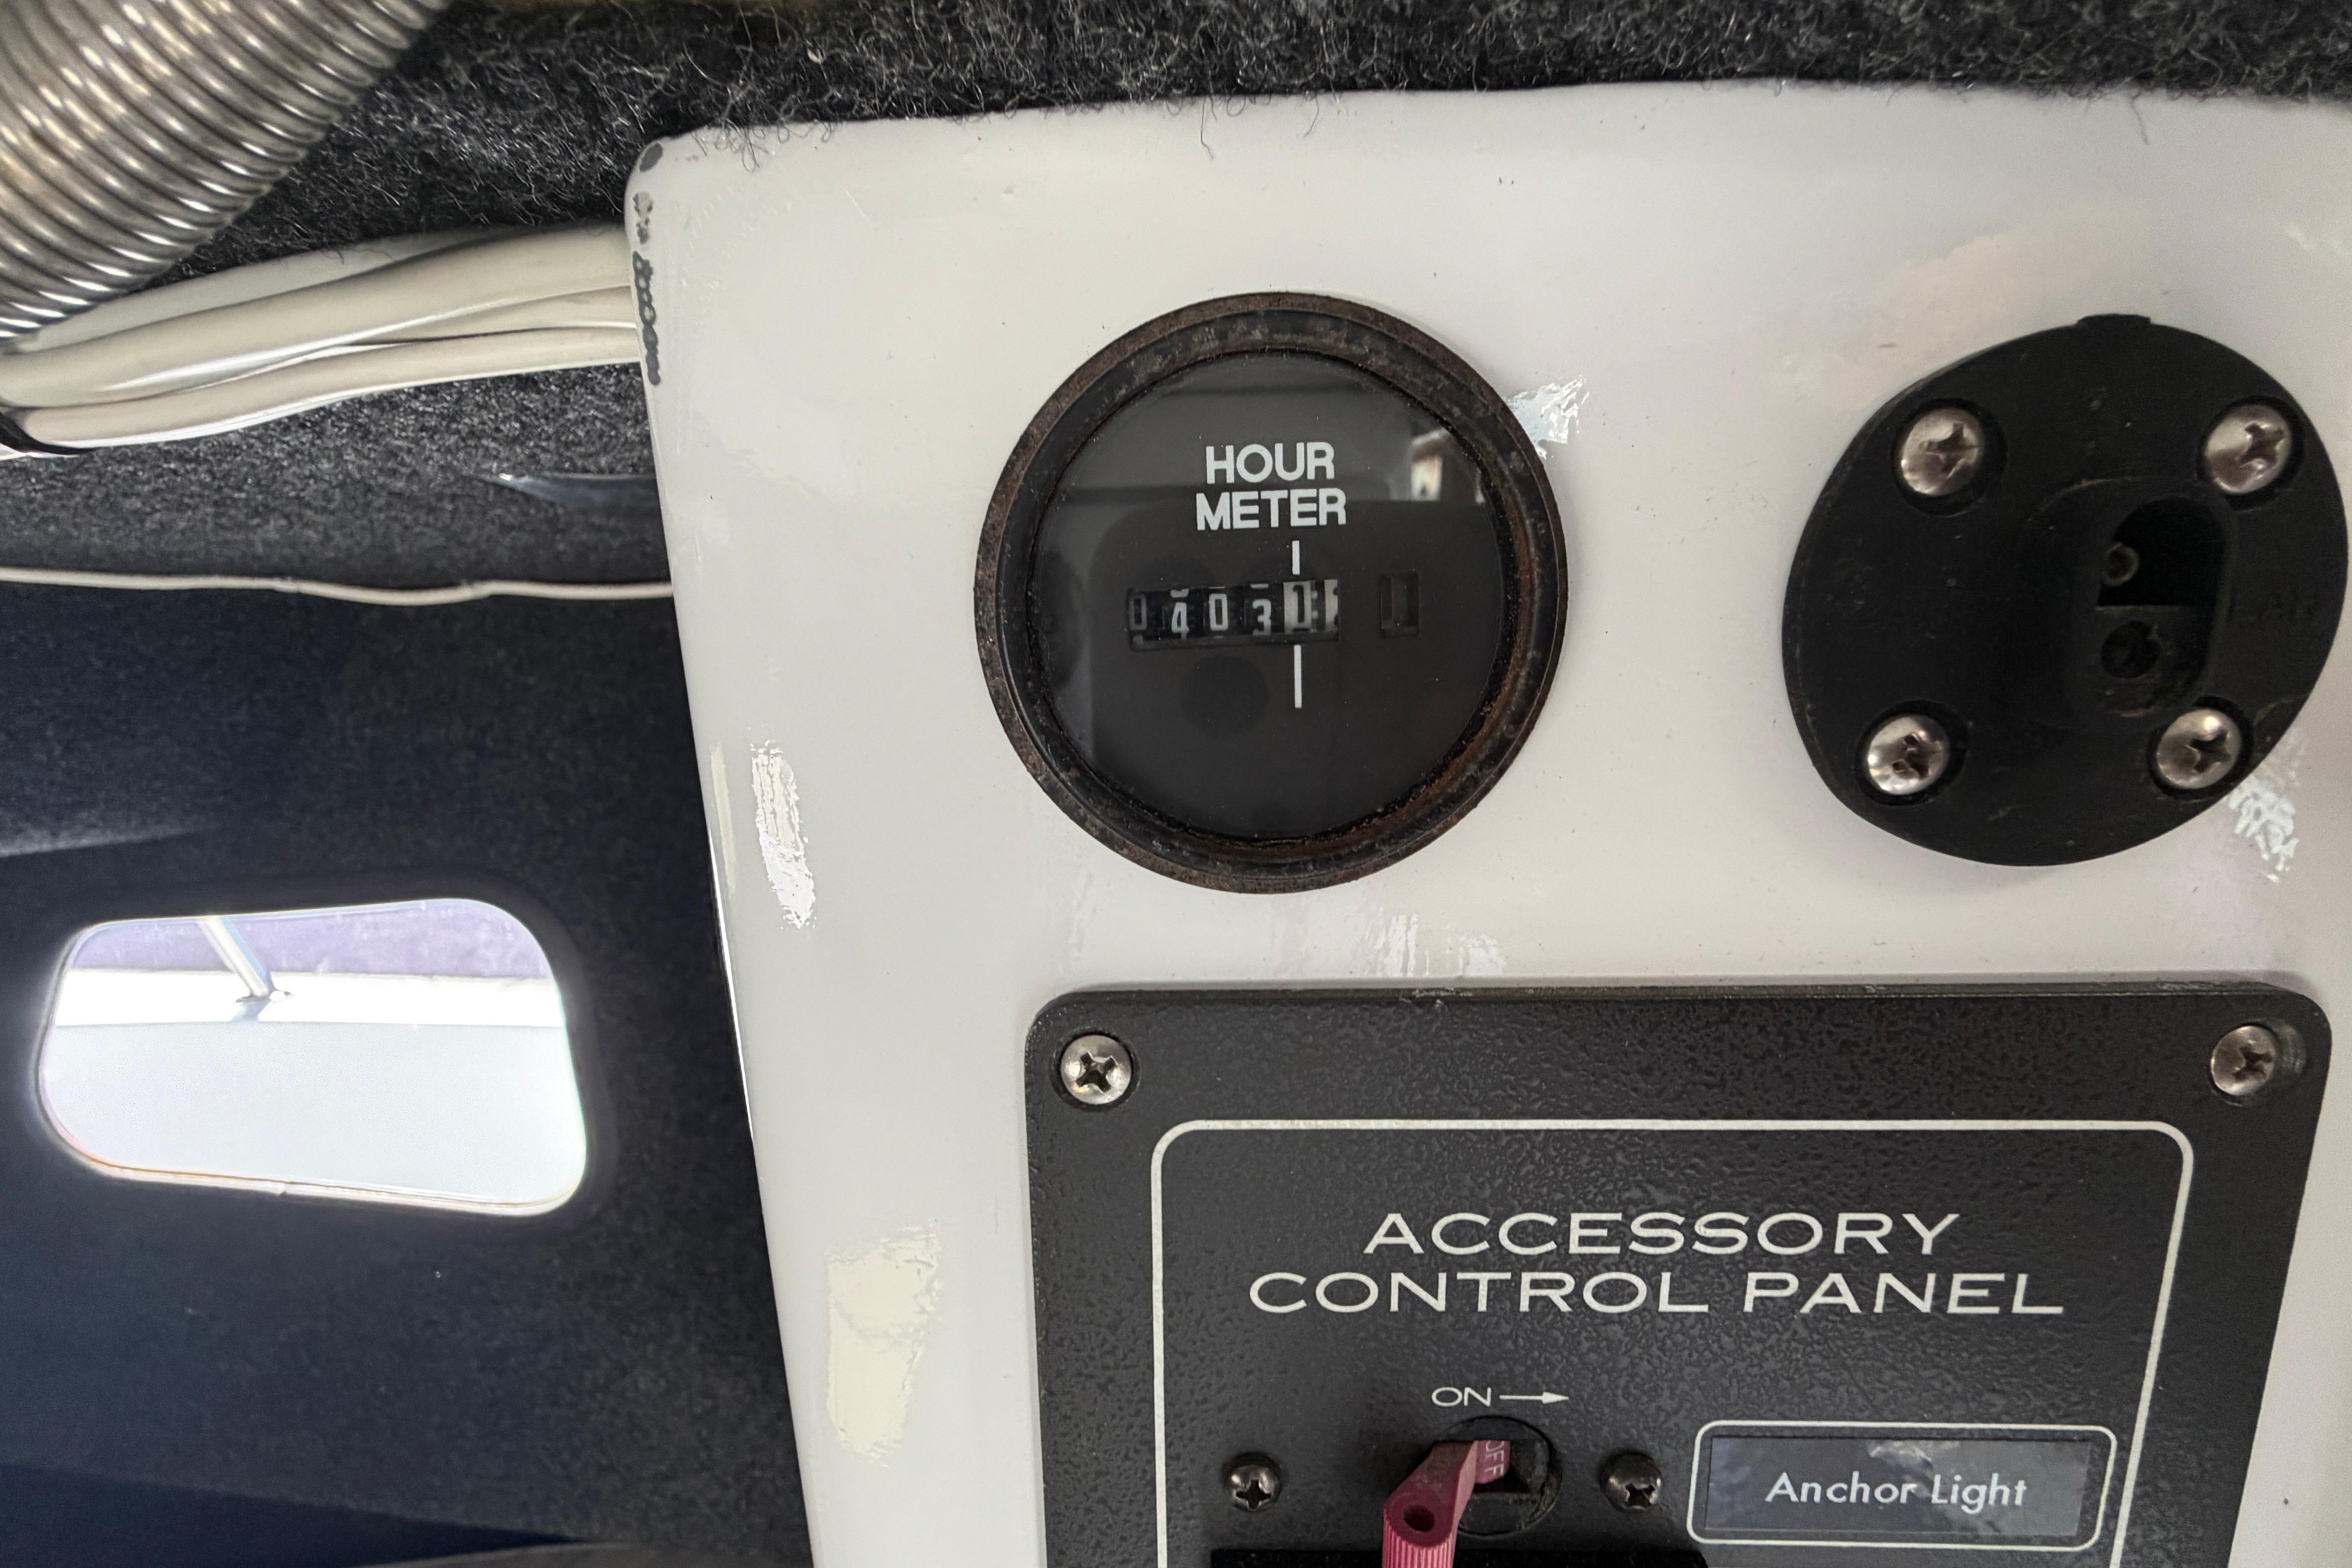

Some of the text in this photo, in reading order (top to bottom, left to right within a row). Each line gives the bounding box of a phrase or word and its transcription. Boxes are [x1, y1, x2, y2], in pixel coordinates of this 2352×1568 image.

[1206, 442, 1335, 484] HOUR
[1196, 488, 1346, 530] METER
[1363, 1211, 1960, 1255] ACCESSORY
[1249, 1271, 2064, 1314] CONTROL PANEL
[1431, 1386, 1491, 1407] ON
[1764, 1470, 2028, 1515] Anchor Light
